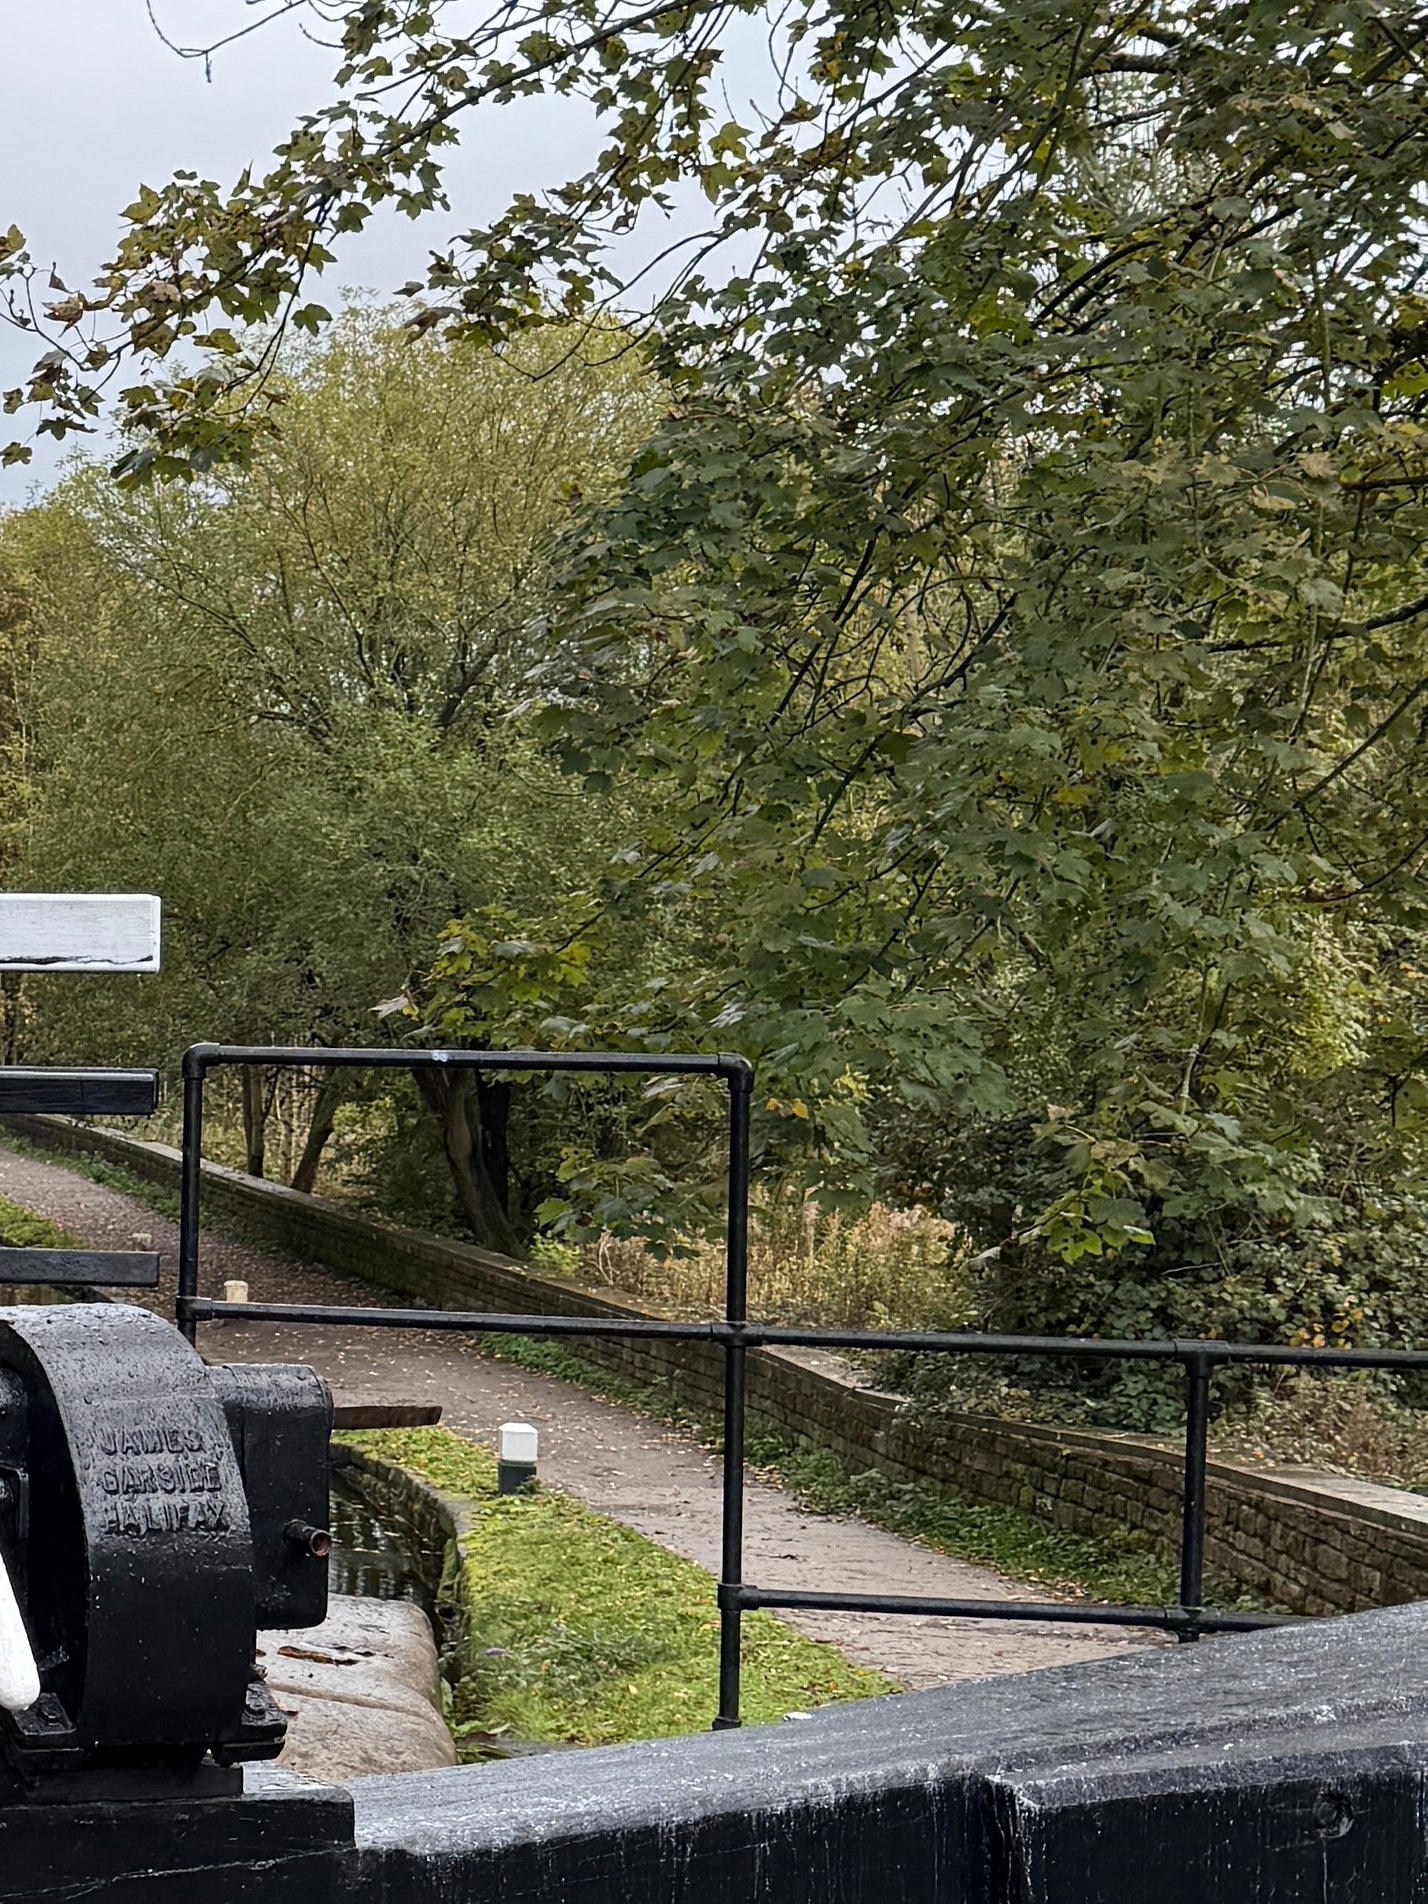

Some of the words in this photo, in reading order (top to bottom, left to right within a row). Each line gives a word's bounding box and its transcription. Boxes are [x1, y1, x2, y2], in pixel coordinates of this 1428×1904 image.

[101, 1427, 206, 1456] JAMES
[102, 1462, 223, 1494] GARSIDE
[100, 1499, 230, 1535] HALIFAX
